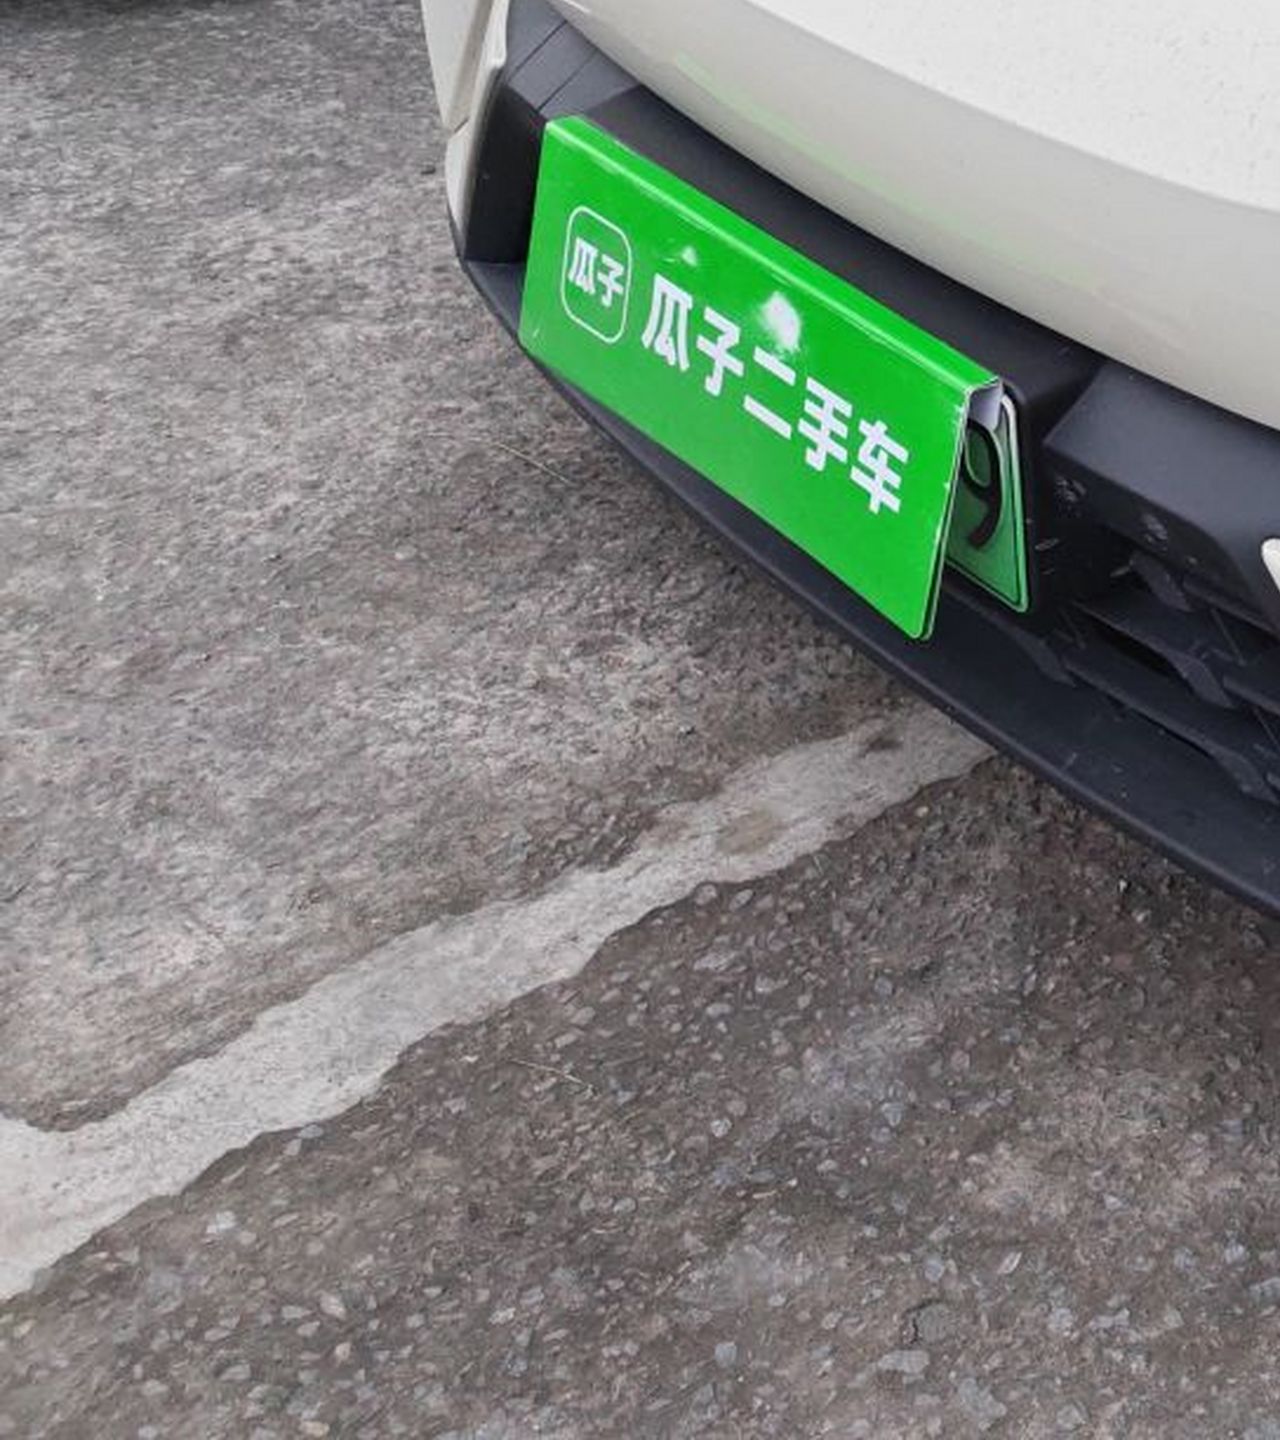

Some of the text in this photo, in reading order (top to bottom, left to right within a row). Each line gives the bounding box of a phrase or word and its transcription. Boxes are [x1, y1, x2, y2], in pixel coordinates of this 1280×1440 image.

[567, 236, 624, 308] 瓜子
[640, 272, 908, 515] 瓜子二手车
